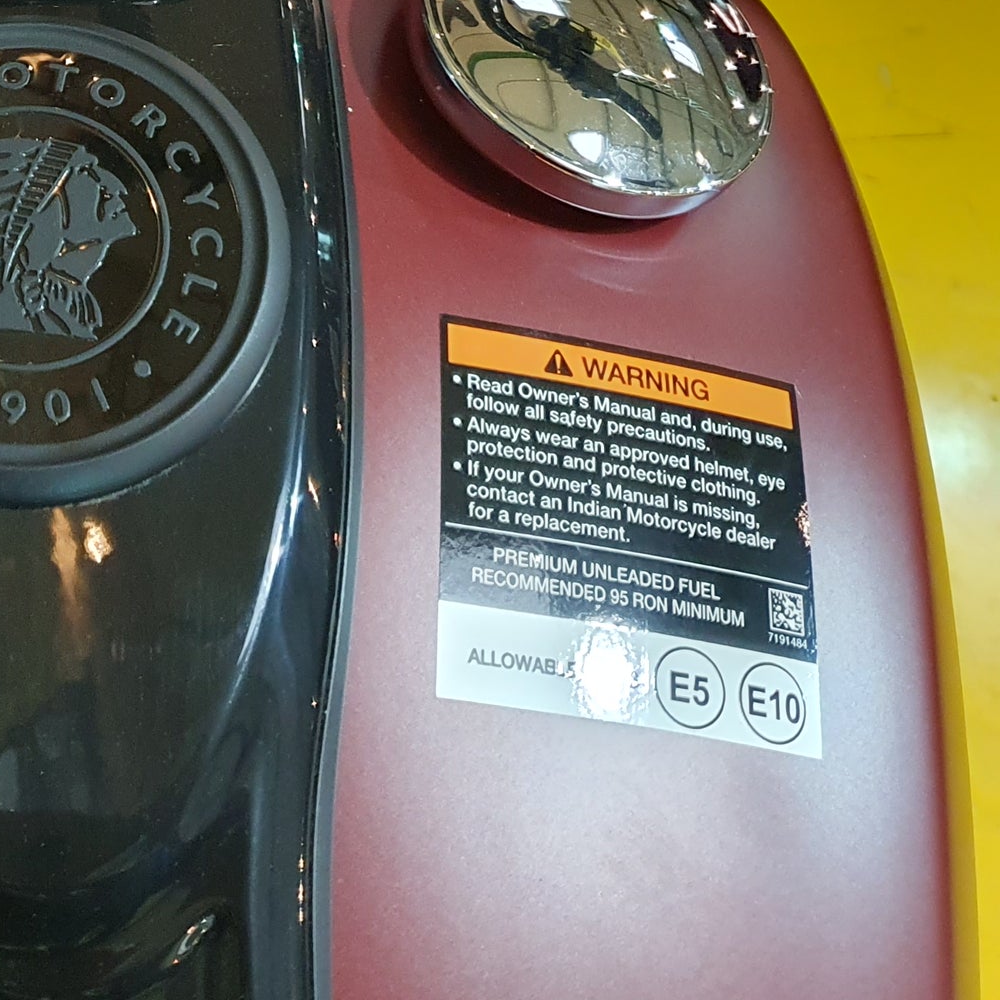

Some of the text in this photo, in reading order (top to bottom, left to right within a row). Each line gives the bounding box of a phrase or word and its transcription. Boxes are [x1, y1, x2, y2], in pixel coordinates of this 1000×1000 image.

[582, 356, 709, 401] WARNING
[467, 373, 787, 451] Read Owner's Manual and, during use,
[467, 393, 710, 451] follow all safety precautions.
[467, 416, 785, 491] Always wear an approved helmet, eye
[467, 440, 760, 507] protection and protective clothing.
[467, 459, 760, 530] If your Owner's Manual is missing,
[467, 484, 776, 550] contact an Indian Motorcycle dealer
[468, 502, 630, 543] for a replacement.
[472, 567, 745, 628] RECOMMENDED 95 RON MINIMUM
[493, 547, 721, 600] PREMIUM UNLEADED FUEL
[768, 632, 807, 649] 7191484
[670, 670, 709, 706] E5
[748, 684, 800, 724] E10
